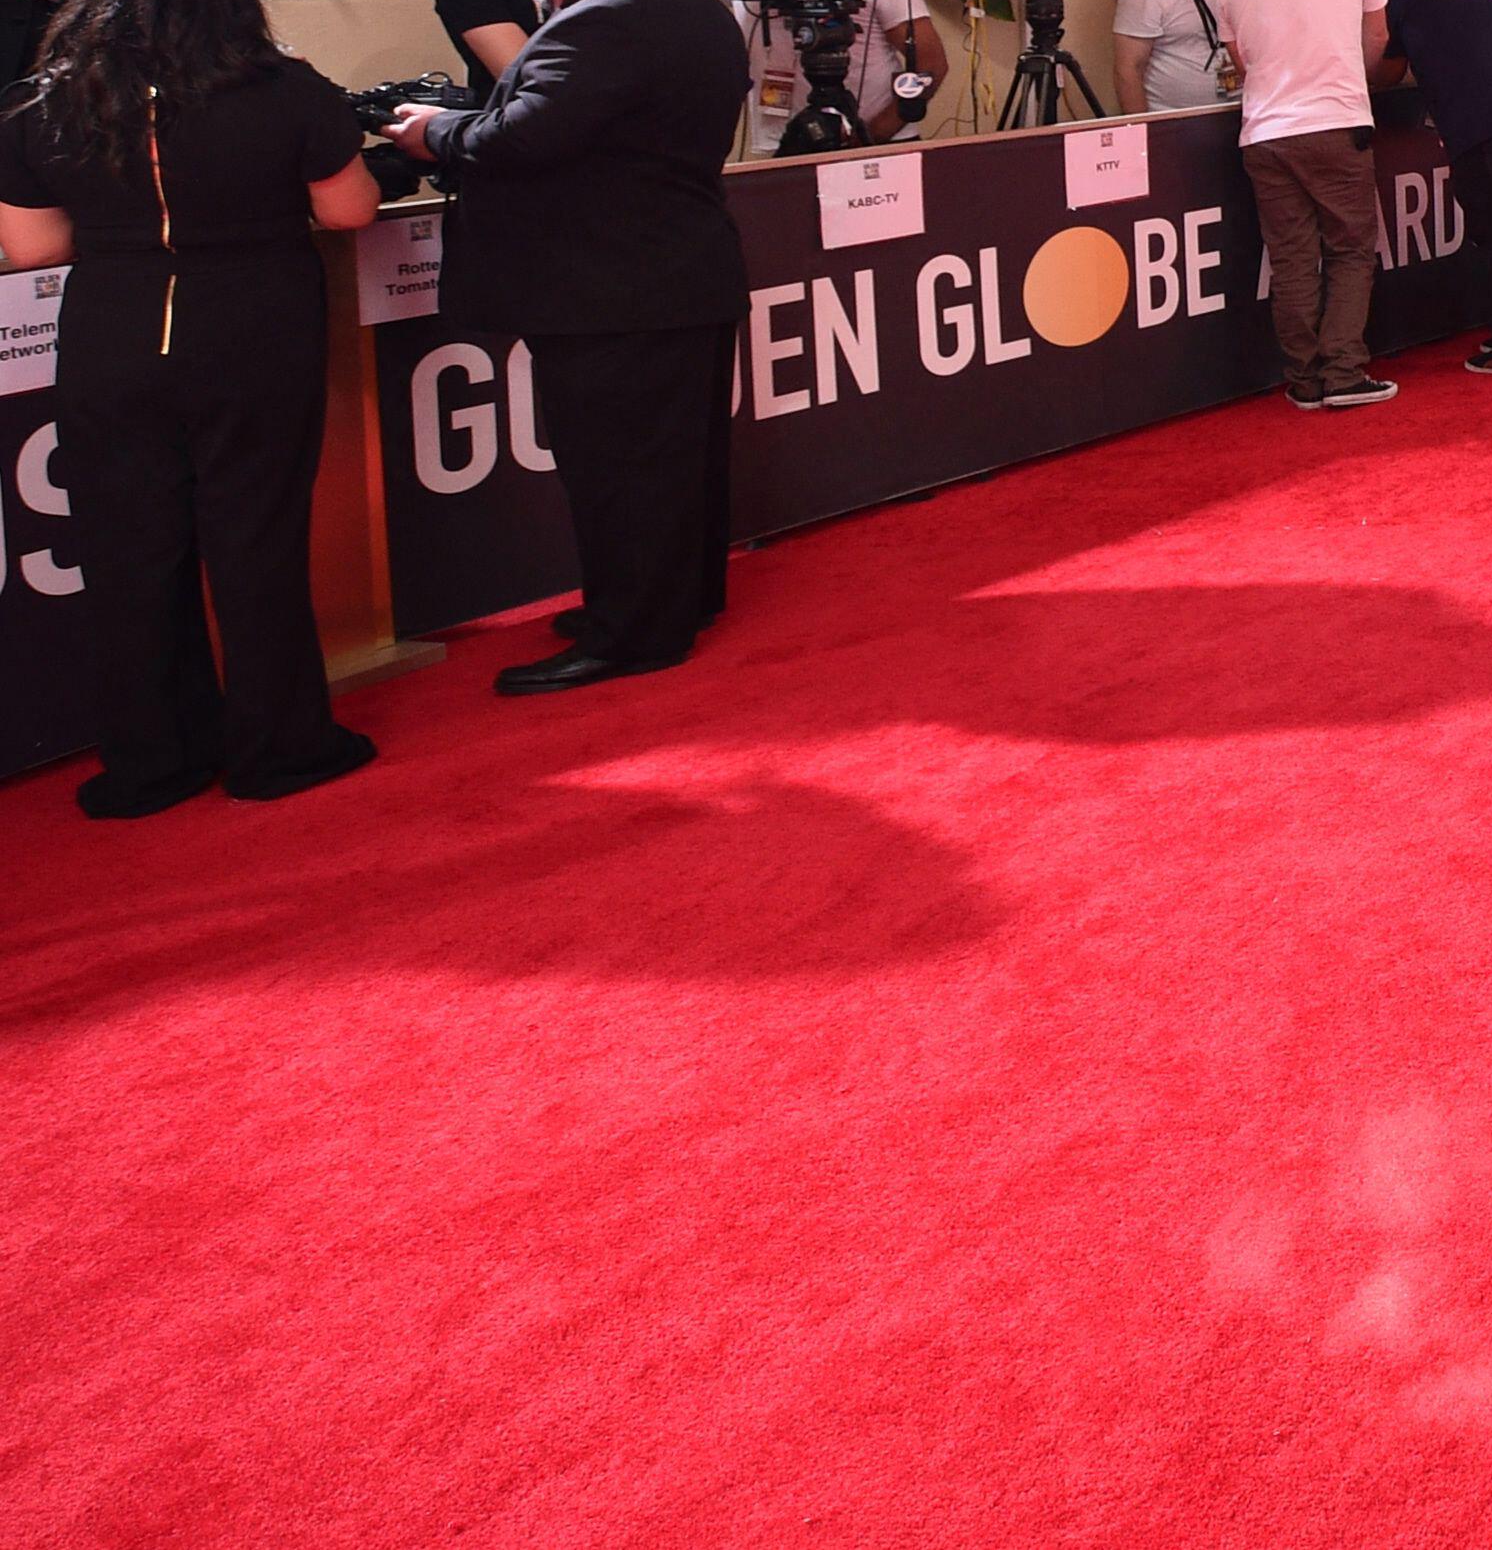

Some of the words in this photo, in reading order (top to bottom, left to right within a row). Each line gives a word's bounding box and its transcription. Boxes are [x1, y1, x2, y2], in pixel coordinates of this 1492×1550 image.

[1096, 160, 1120, 172] KTTV
[848, 192, 899, 210] KABC-TV
[397, 261, 440, 276] Rotte
[385, 278, 440, 296] Tomat
[916, 207, 1226, 377] GLOBE
[0, 322, 56, 341] Telem
[0, 338, 59, 361] etwor
